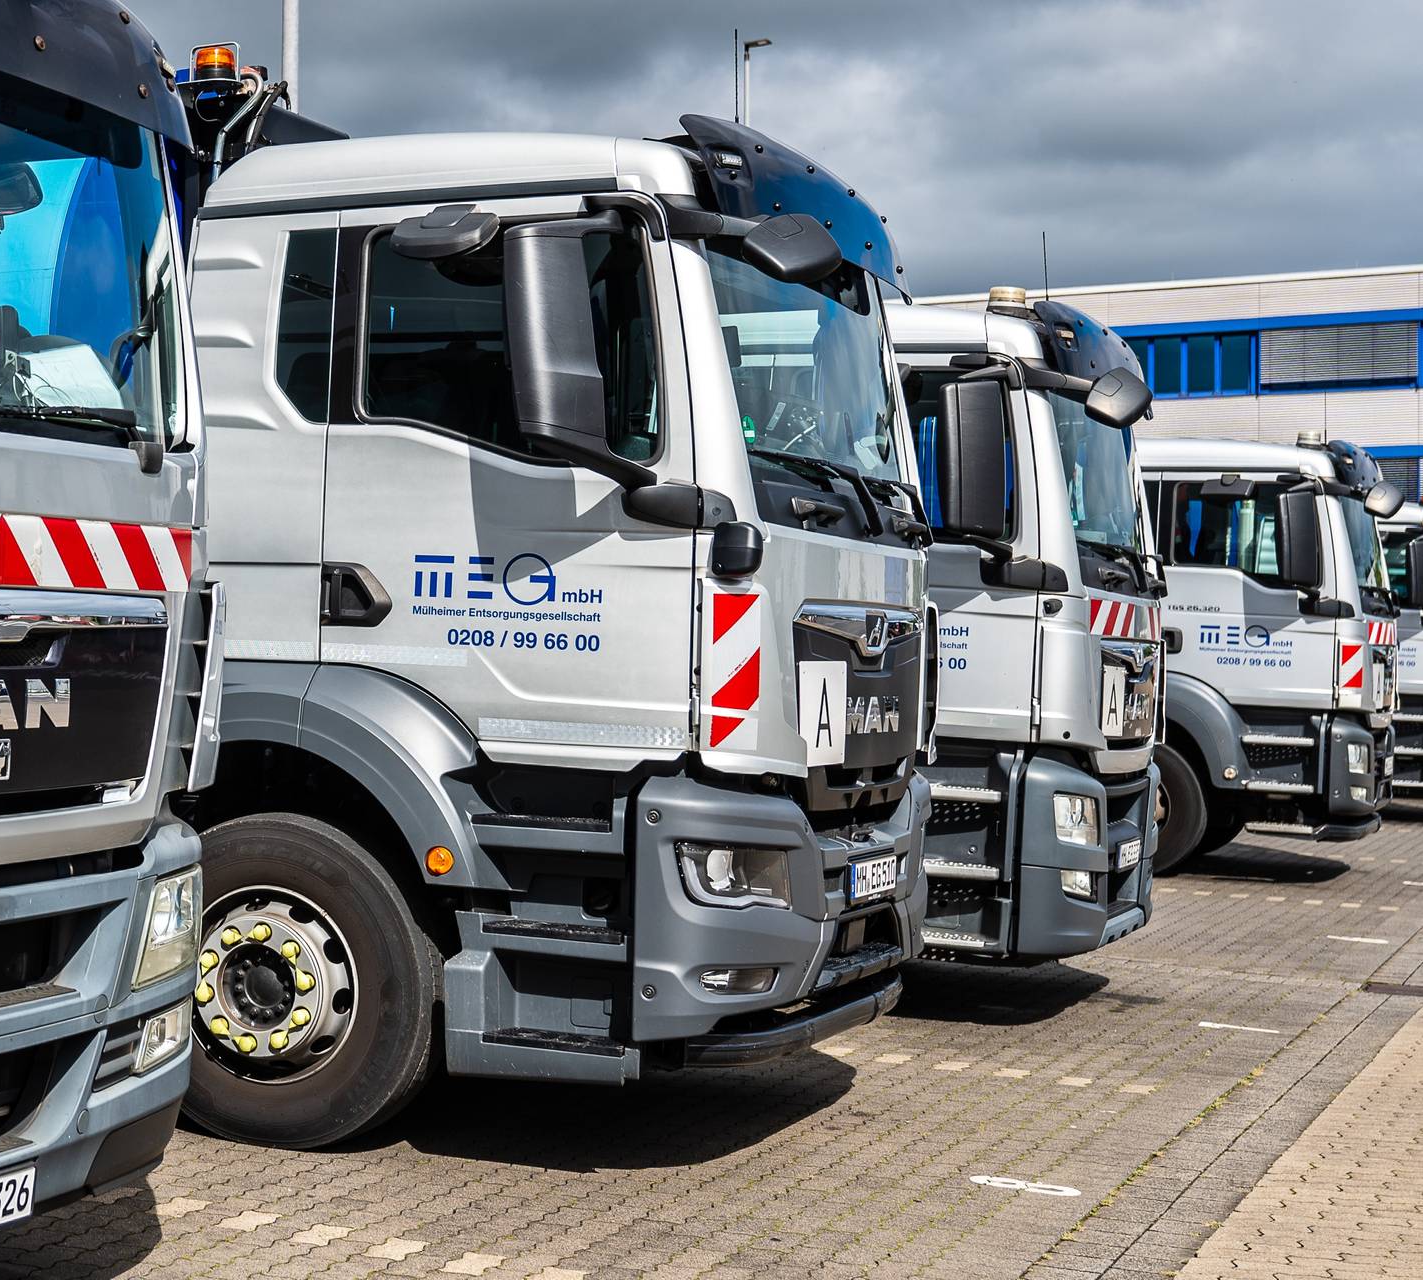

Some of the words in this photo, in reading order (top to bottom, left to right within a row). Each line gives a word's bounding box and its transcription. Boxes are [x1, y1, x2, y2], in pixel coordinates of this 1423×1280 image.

[414, 553, 556, 605] MEG
[562, 589, 603, 604] mbH
[412, 605, 467, 617] Mülheimer
[468, 608, 601, 622] Entsorgungsgesellschaft
[447, 628, 495, 647] 0208
[500, 630, 508, 648] /
[513, 631, 537, 649] 99
[544, 632, 568, 650] 66
[575, 634, 600, 651] 00
[939, 626, 969, 637] mbH
[1200, 624, 1270, 648] MEG
[1272, 640, 1293, 648] mbH
[948, 657, 967, 670] 00
[1216, 656, 1240, 665] 0208
[1250, 657, 1261, 667] 99
[1264, 658, 1276, 667] 66
[1279, 658, 1292, 668] 00
[816, 677, 832, 748] A
[1107, 681, 1118, 726] A
[845, 696, 899, 735] MAN
